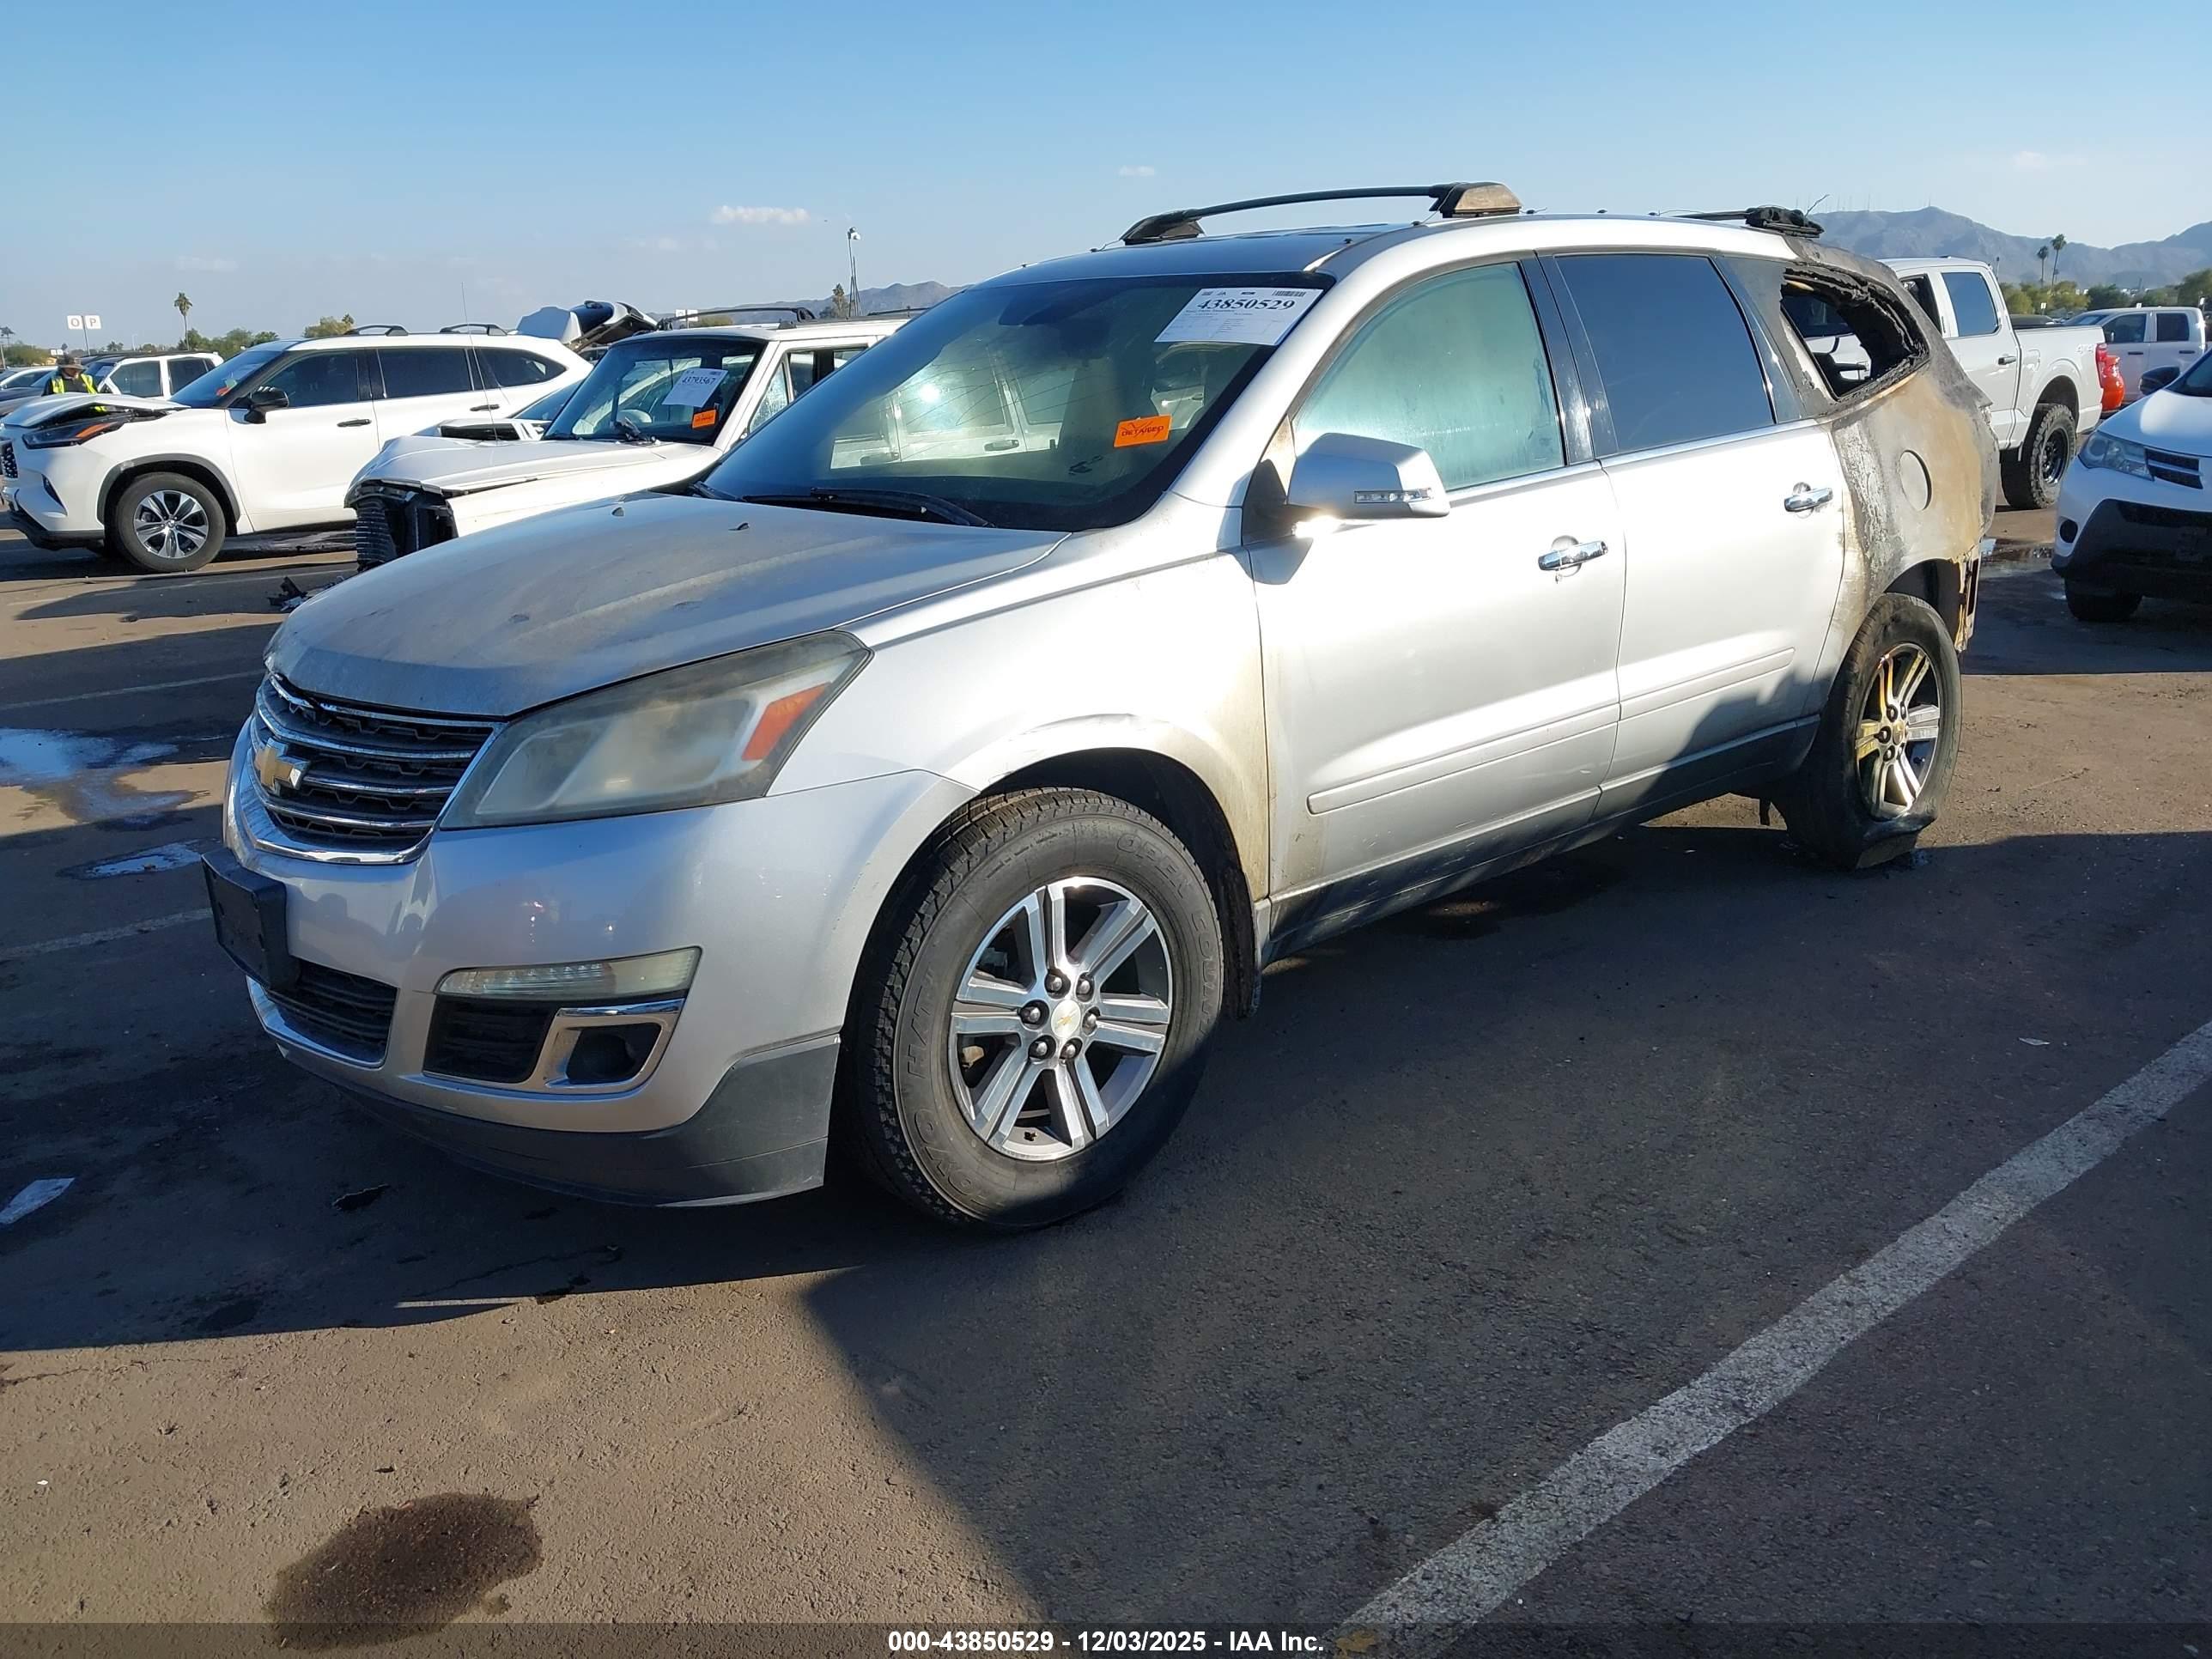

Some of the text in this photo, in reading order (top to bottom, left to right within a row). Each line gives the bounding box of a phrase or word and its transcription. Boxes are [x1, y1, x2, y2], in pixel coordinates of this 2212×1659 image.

[1197, 299, 1295, 310] 43850529
[70, 318, 96, 327] O P
